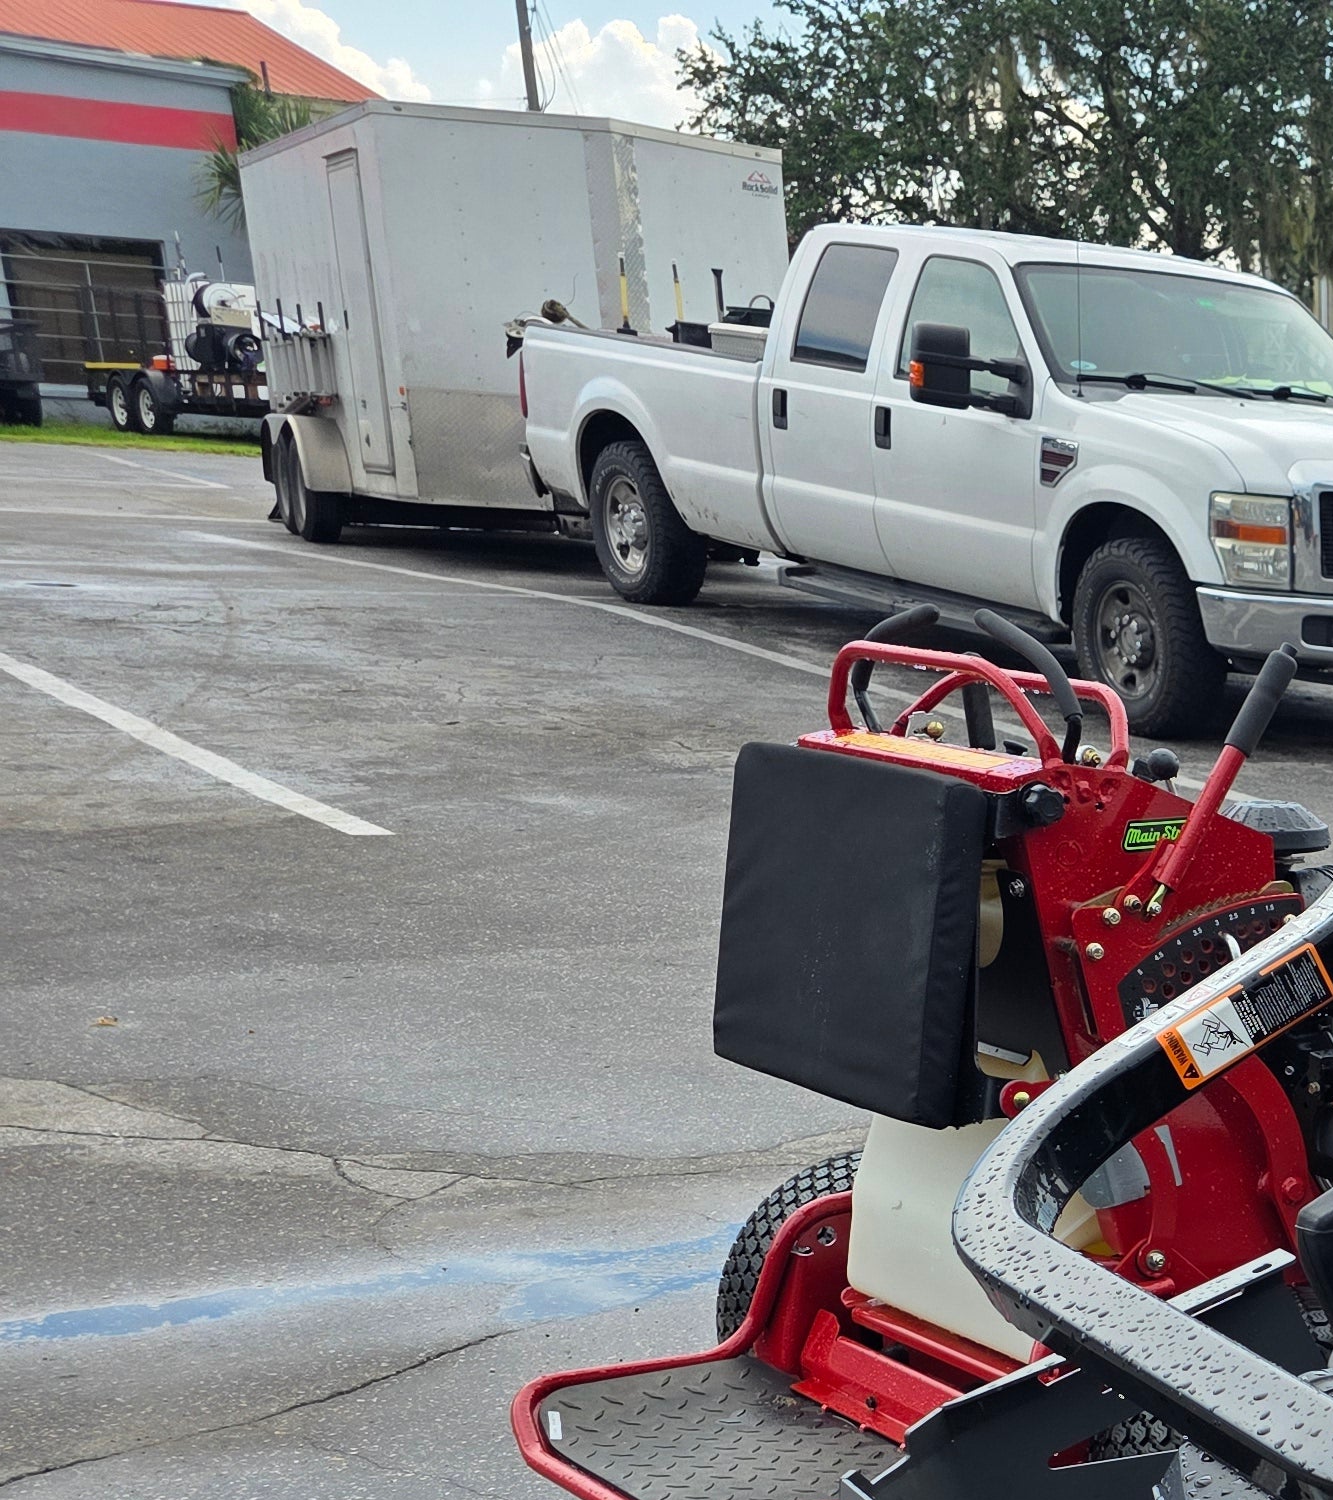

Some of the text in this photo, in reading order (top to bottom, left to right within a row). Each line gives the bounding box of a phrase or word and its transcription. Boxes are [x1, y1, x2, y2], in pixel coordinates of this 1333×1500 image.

[1127, 827, 1161, 844] Main
[1250, 907, 1256, 915] 2
[1265, 903, 1275, 912] 1.5
[1228, 912, 1239, 921] 2.5
[1214, 919, 1220, 927] 3
[1154, 951, 1165, 962] 4.5
[1163, 1031, 1189, 1066] WARNING
